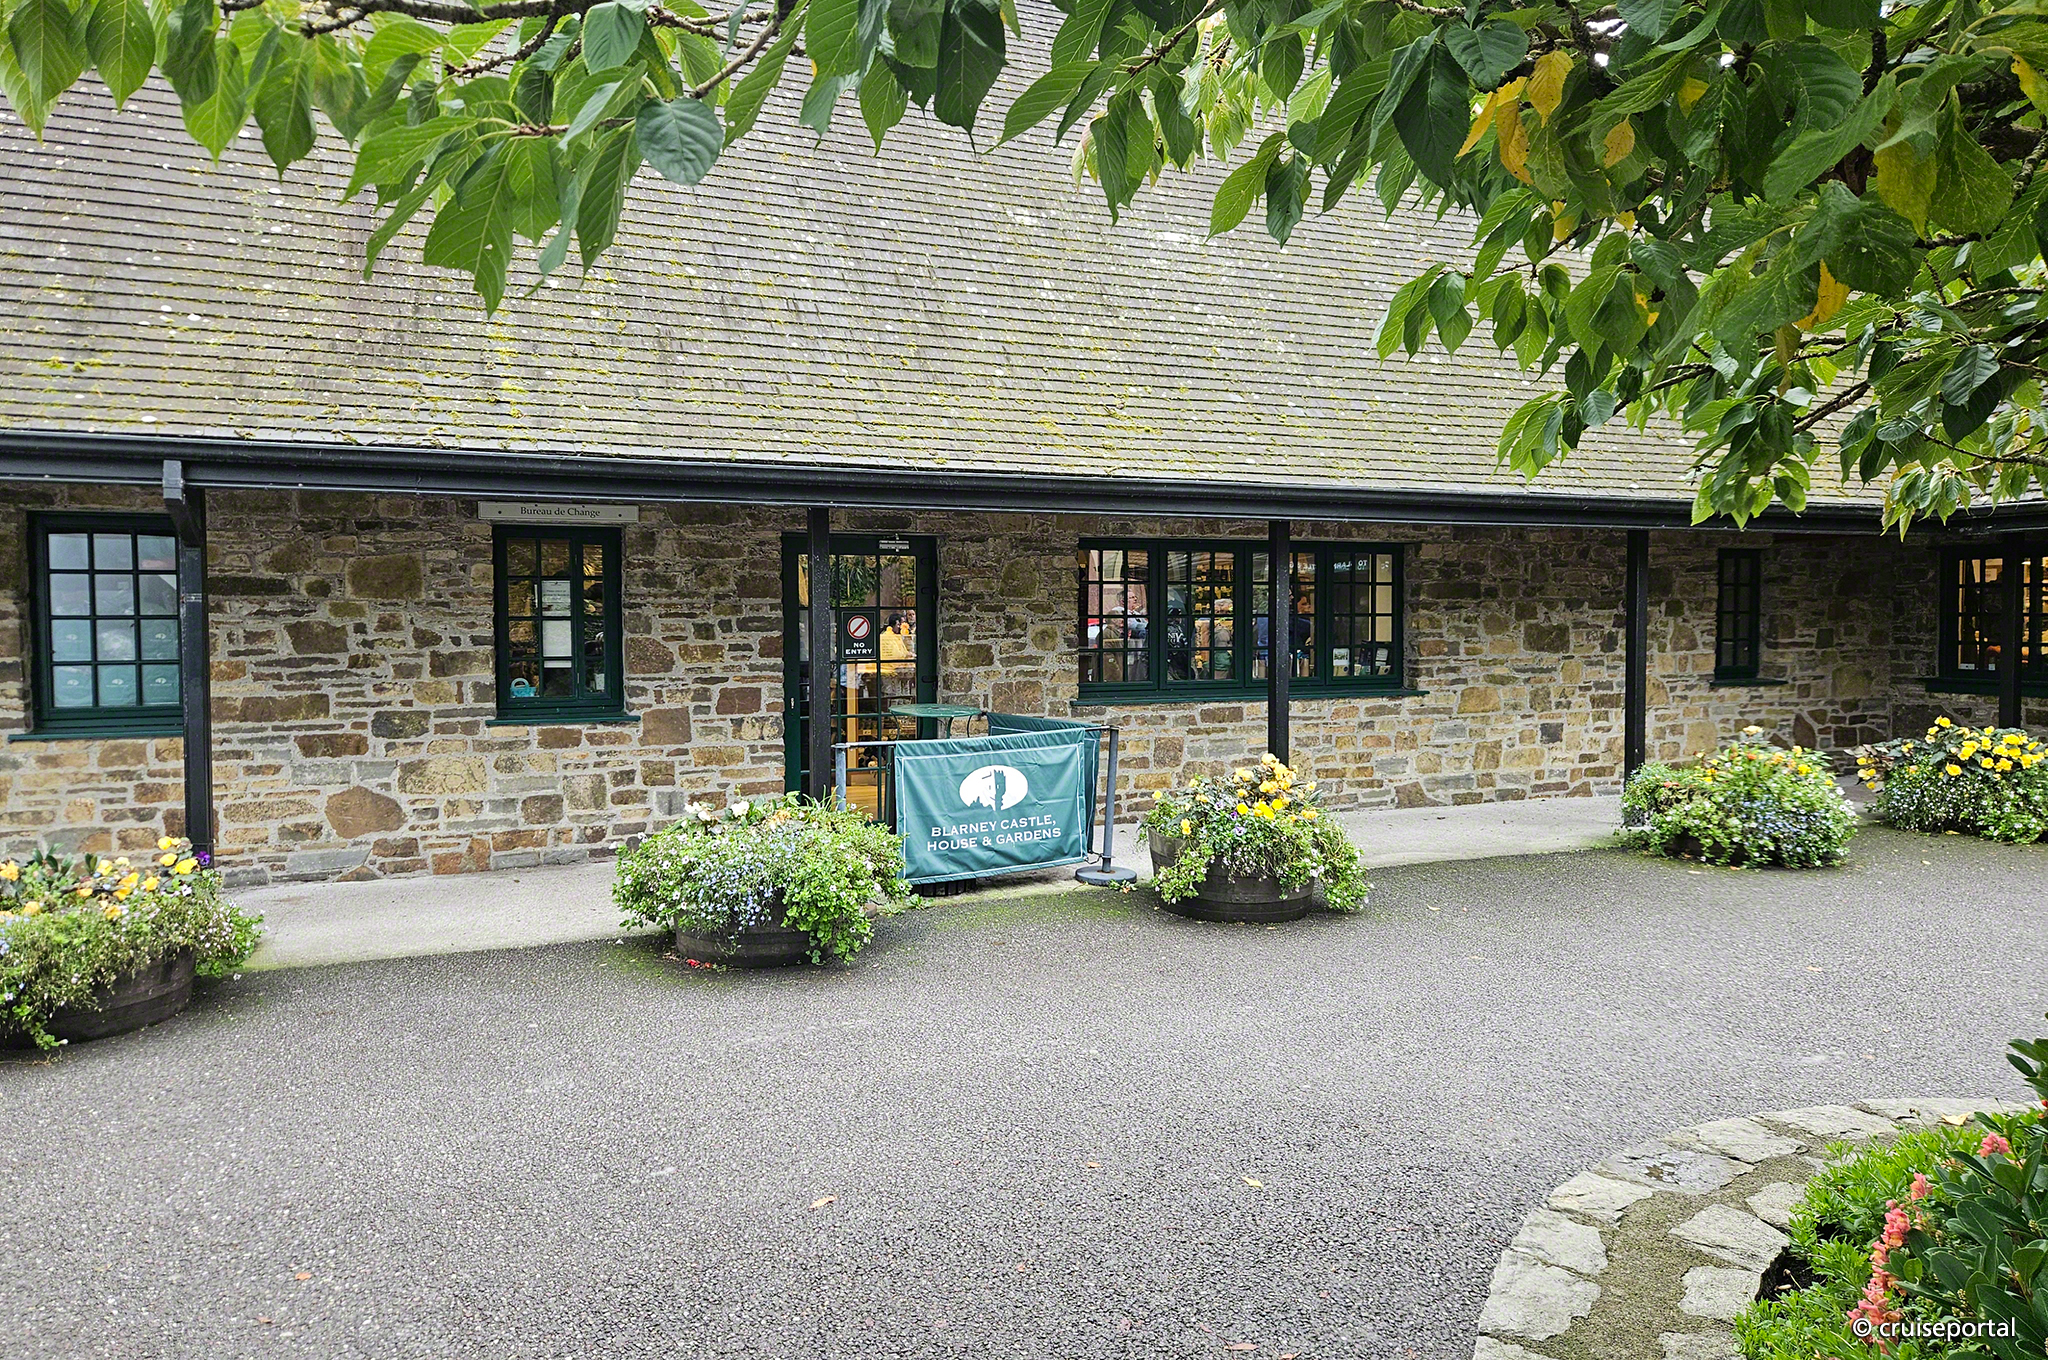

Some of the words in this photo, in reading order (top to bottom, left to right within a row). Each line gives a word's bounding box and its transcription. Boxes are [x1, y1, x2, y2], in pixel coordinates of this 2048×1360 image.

[520, 506, 551, 515] Bureau
[554, 507, 565, 516] de
[567, 507, 600, 518] Change
[931, 820, 998, 837] BLARNEY
[1000, 814, 1057, 830] CASTLE,
[927, 837, 978, 852] HOUSE
[982, 836, 992, 846] &
[996, 827, 1061, 844] GARDENS
